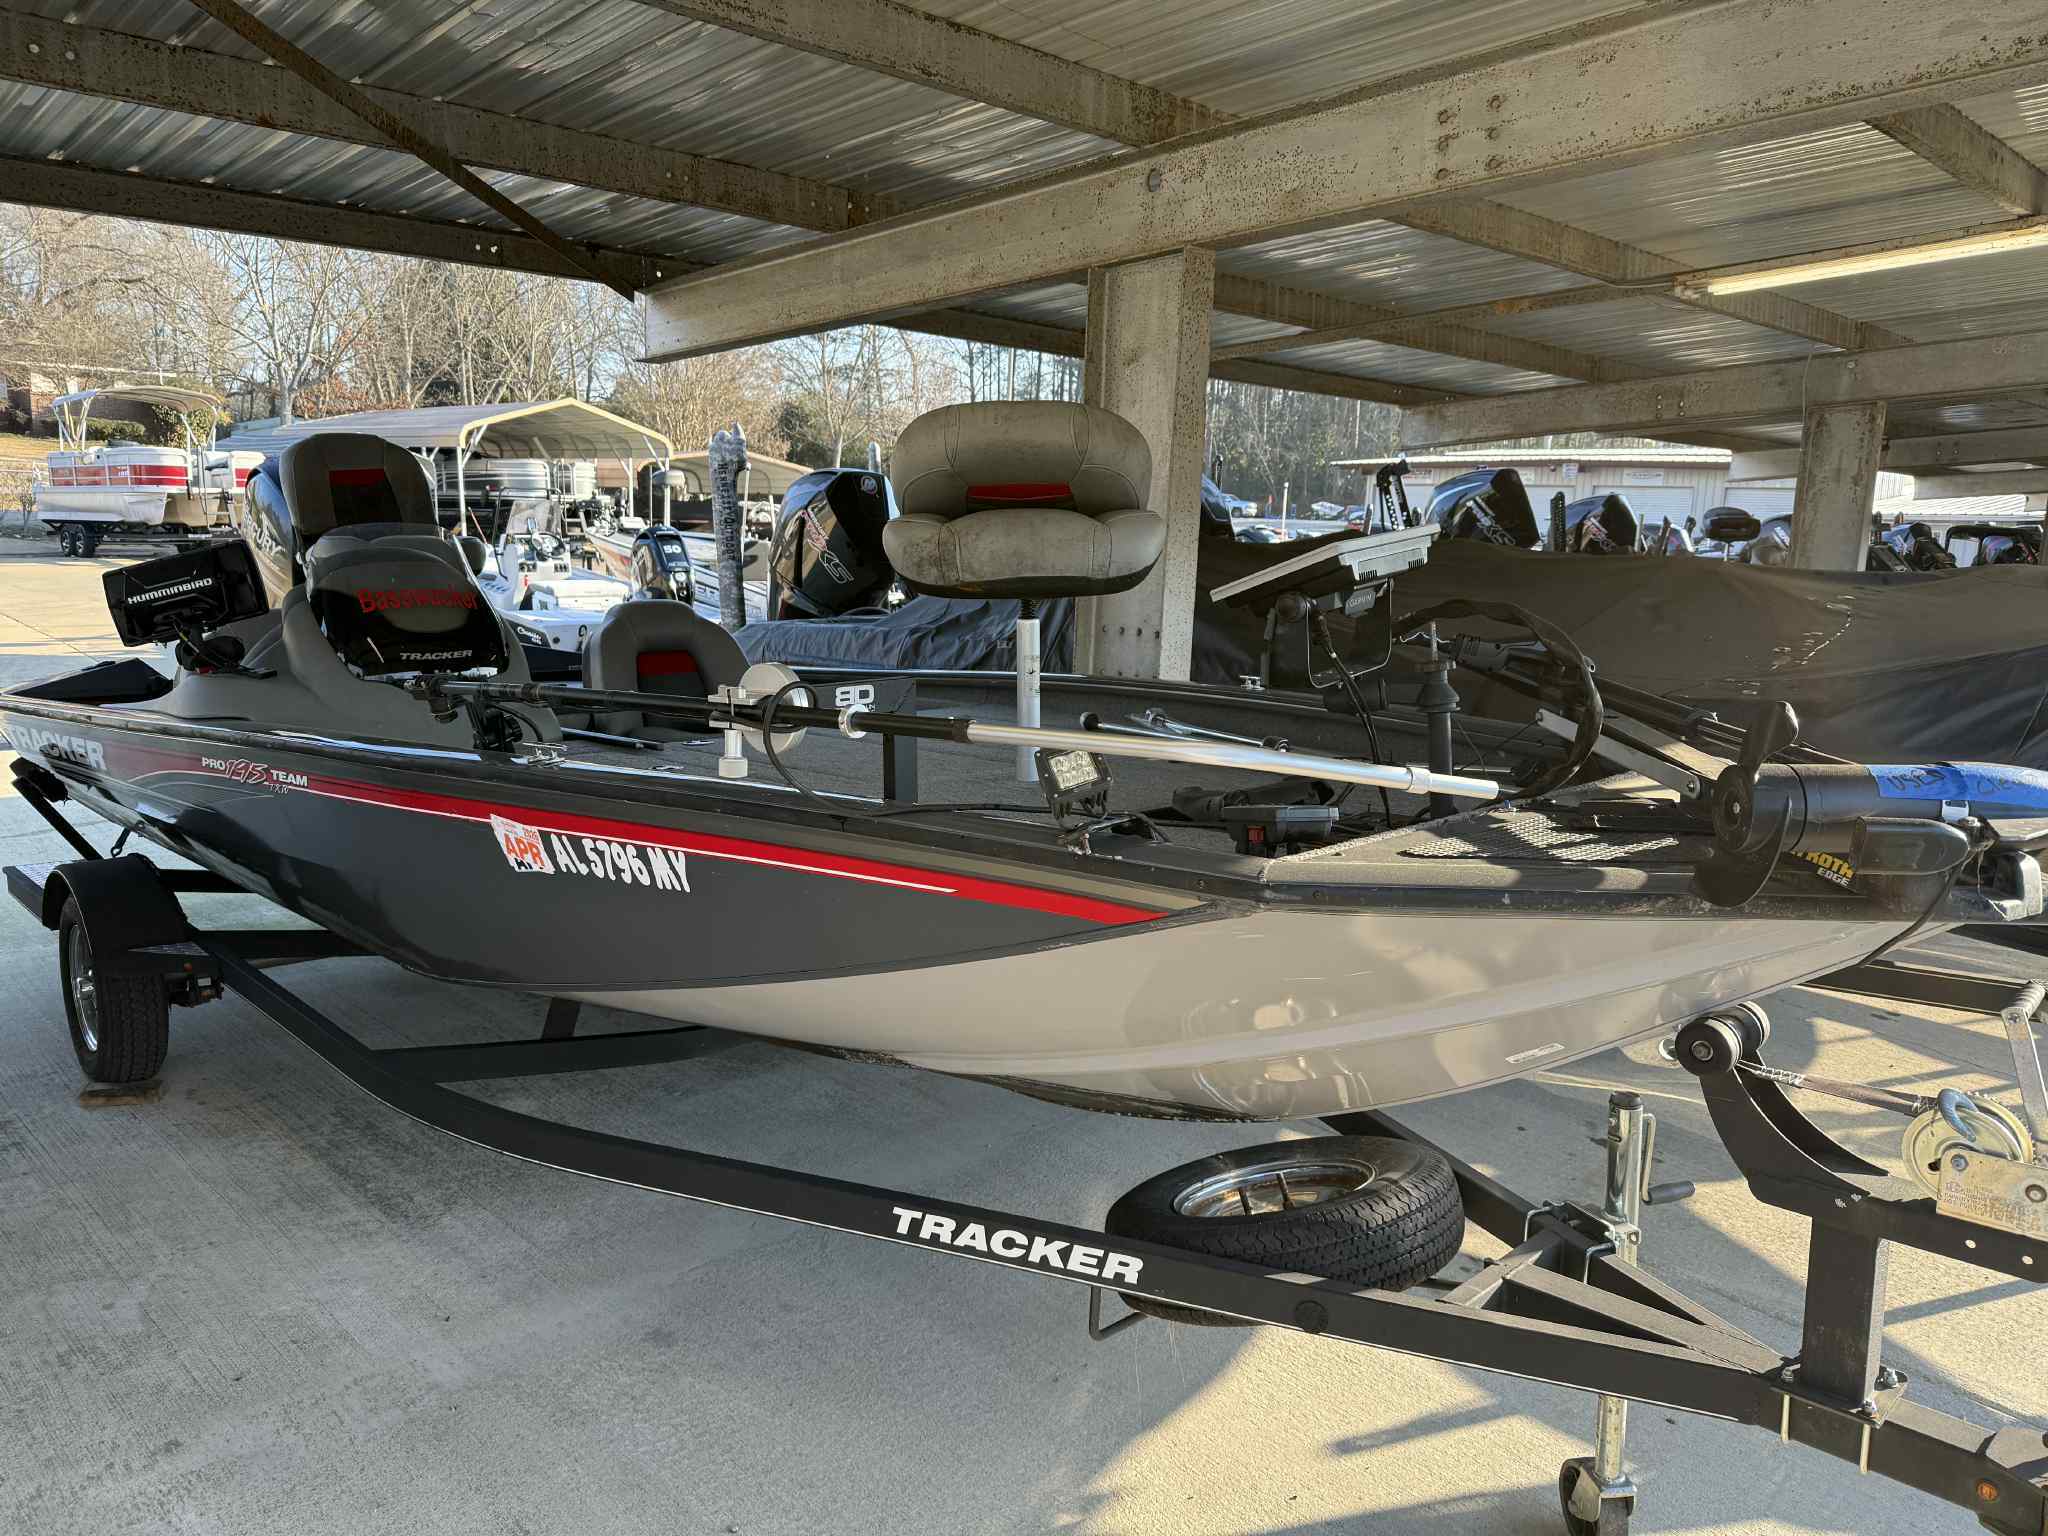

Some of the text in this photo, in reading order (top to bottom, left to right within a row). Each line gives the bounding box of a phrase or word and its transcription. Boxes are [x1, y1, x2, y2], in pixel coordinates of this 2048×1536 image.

[663, 544, 682, 554] 50
[127, 577, 213, 605] HUMMINBIRD
[399, 649, 473, 661] TRACKER
[201, 756, 225, 771] PRO
[269, 769, 308, 787] TEAM
[504, 832, 545, 868] APR
[550, 833, 691, 893] AL 5796 MY
[1817, 867, 1850, 888] EDGE
[892, 1206, 1144, 1285] TRACKER
